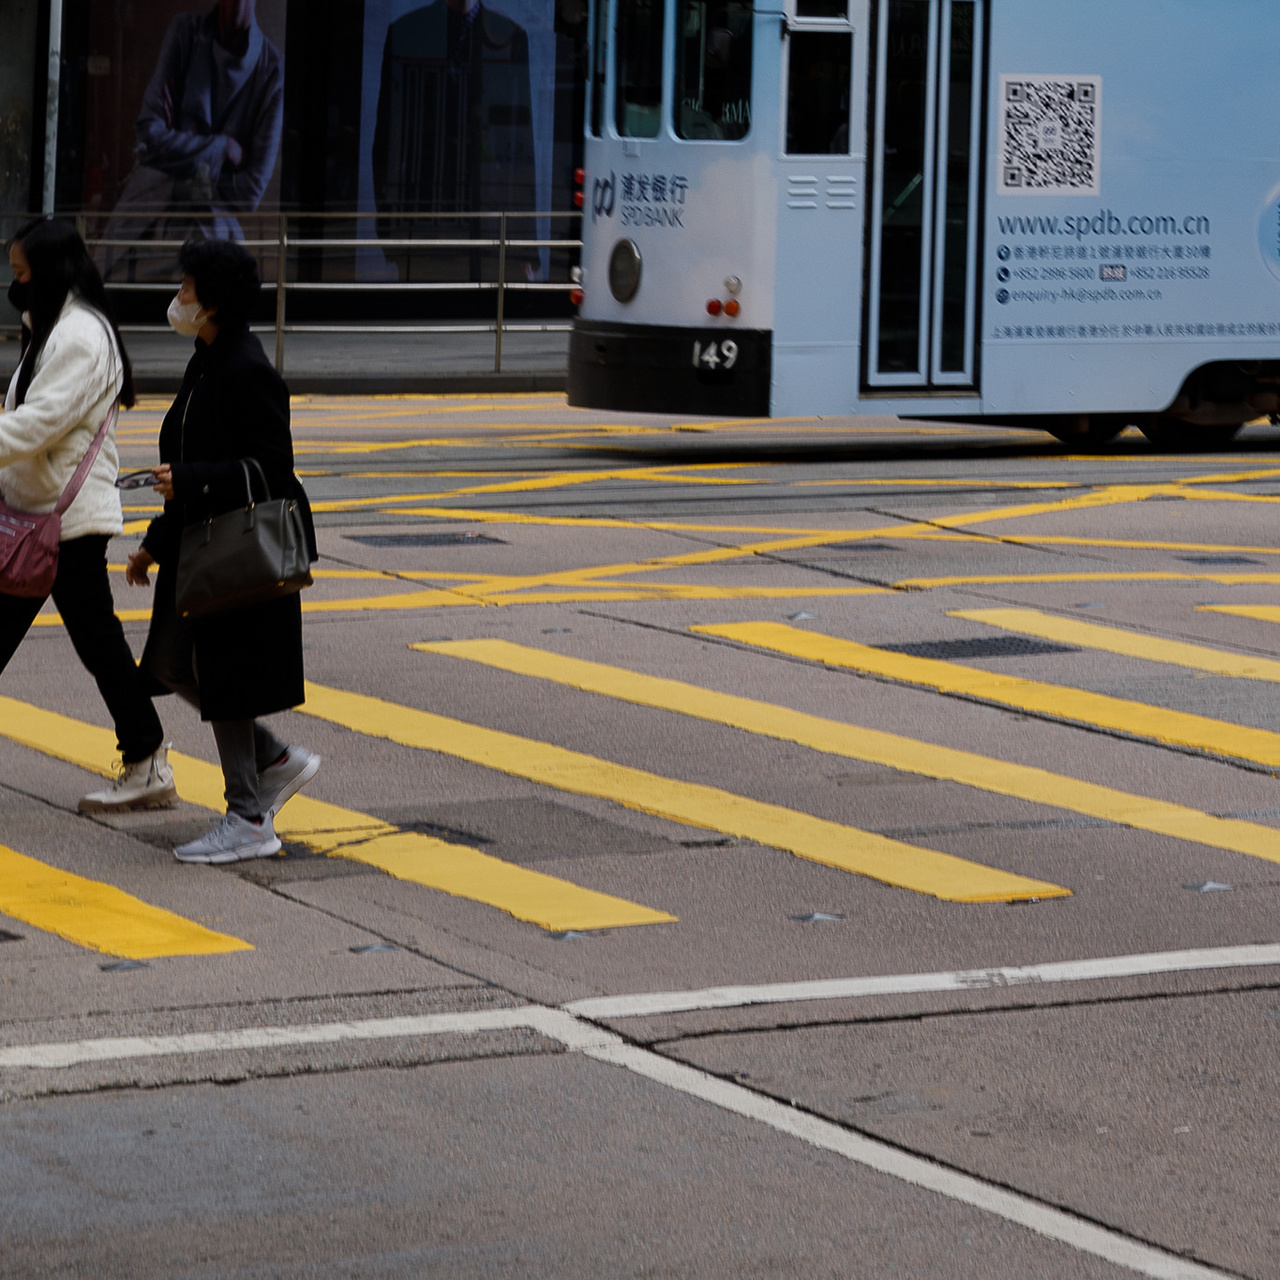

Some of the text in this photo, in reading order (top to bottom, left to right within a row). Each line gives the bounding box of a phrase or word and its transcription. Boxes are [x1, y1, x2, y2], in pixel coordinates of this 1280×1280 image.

[621, 171, 689, 204] 浦发银行
[997, 208, 1211, 241] www.spdb.com.cn
[692, 340, 738, 369] 149
